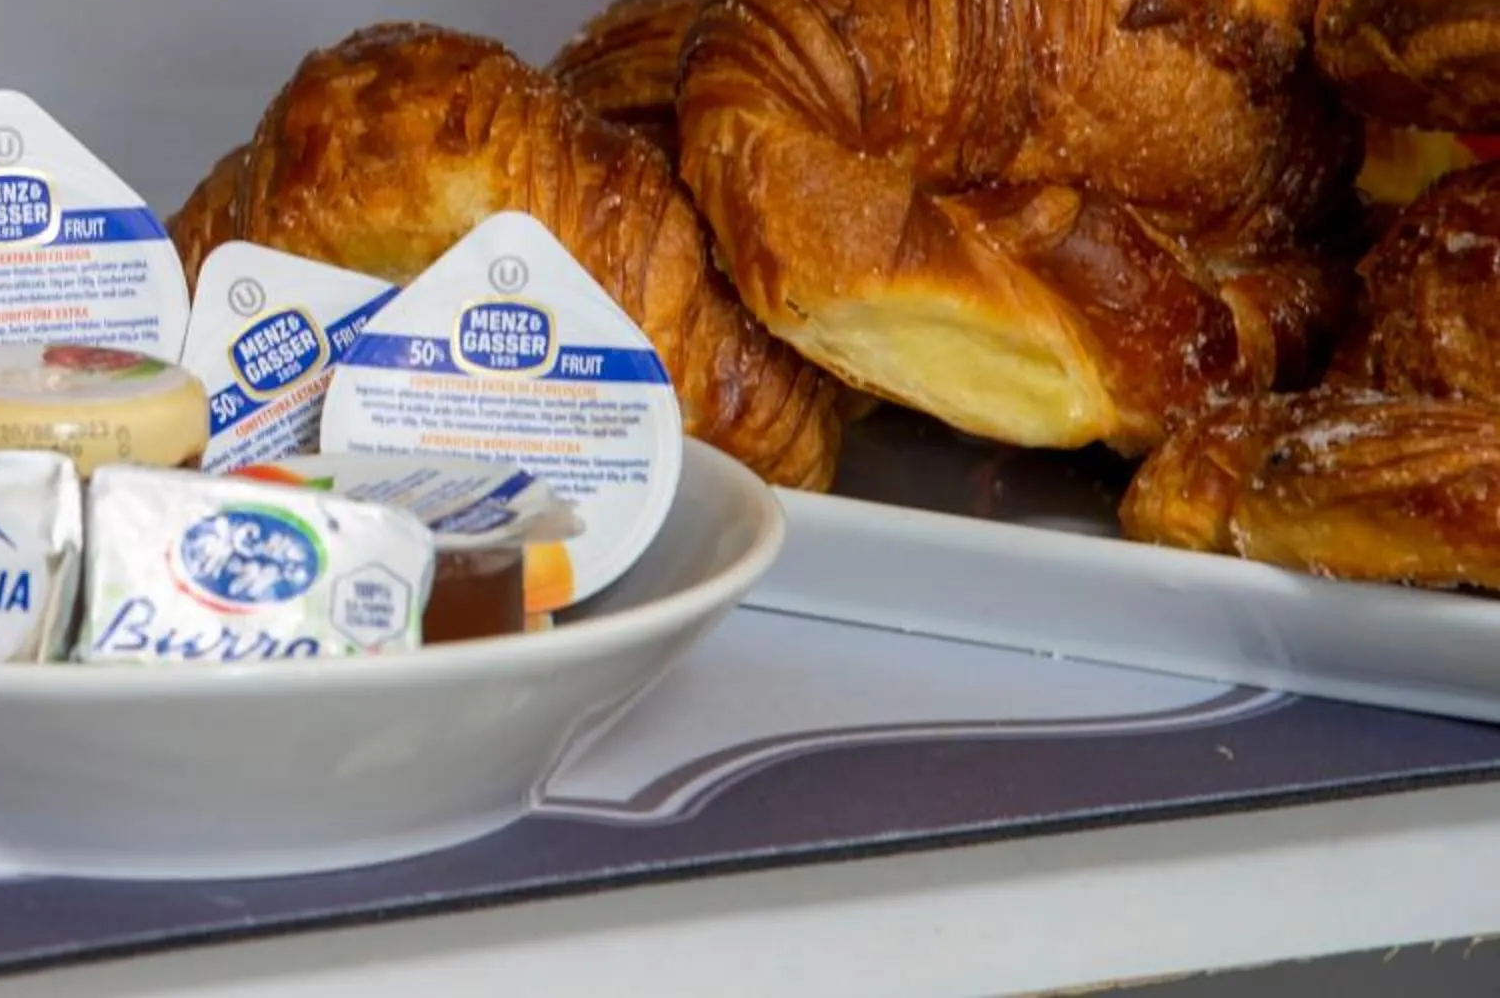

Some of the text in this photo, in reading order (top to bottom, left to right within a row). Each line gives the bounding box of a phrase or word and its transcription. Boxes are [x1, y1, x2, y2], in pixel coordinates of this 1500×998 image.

[64, 217, 106, 239] FRUIT
[463, 331, 546, 356] GASSER
[244, 330, 317, 383] GASSER
[561, 354, 603, 375] FRUIT
